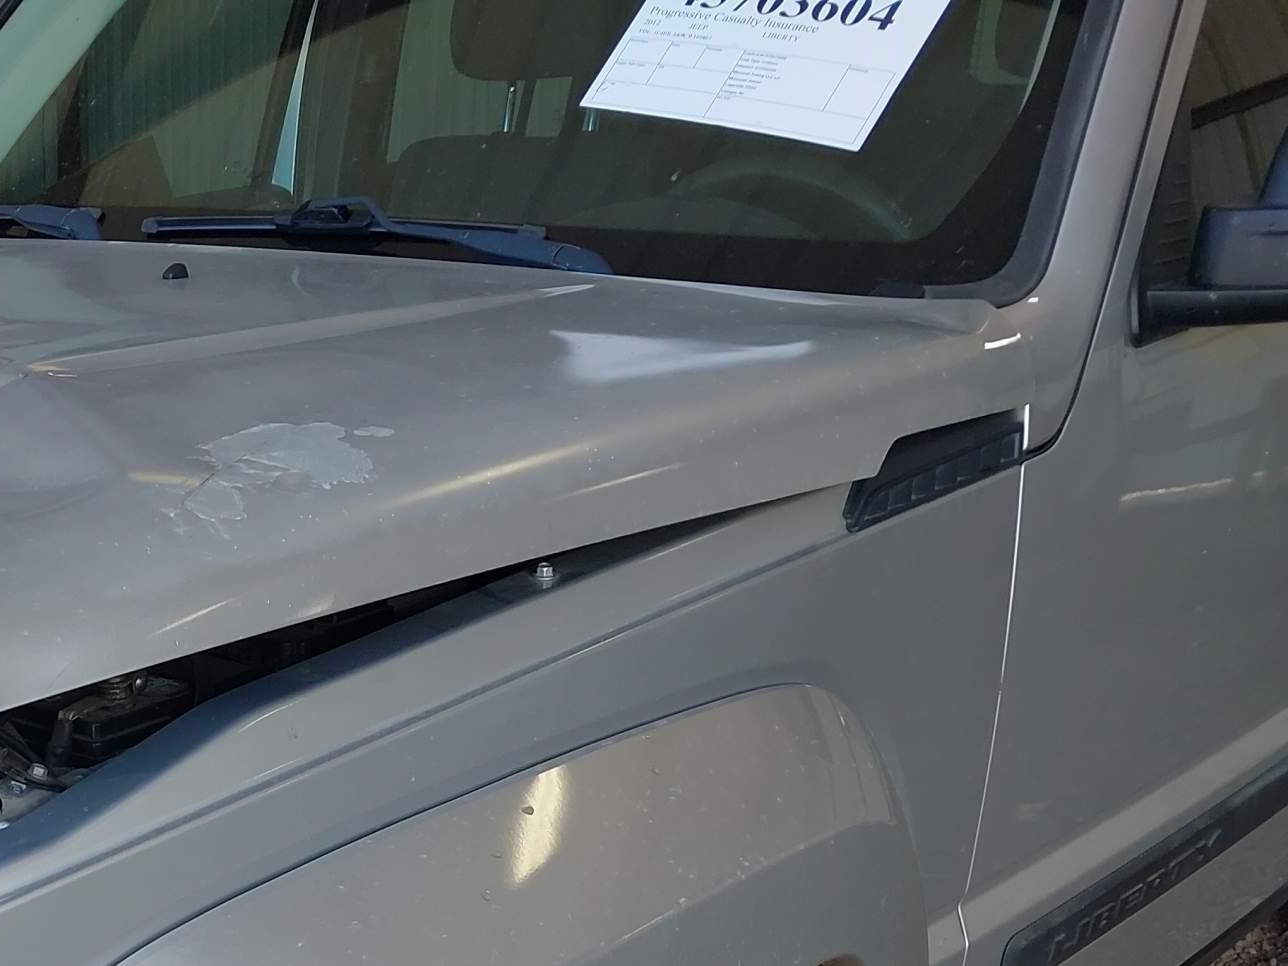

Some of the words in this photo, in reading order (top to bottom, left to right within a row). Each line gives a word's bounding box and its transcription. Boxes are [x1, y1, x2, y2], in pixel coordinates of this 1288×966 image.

[649, 6, 712, 21] Progressive
[714, 12, 762, 28] Casualty
[764, 17, 820, 33] Insurance
[685, 0, 904, 31] 3604
[1046, 828, 1223, 962] LIBERTY
